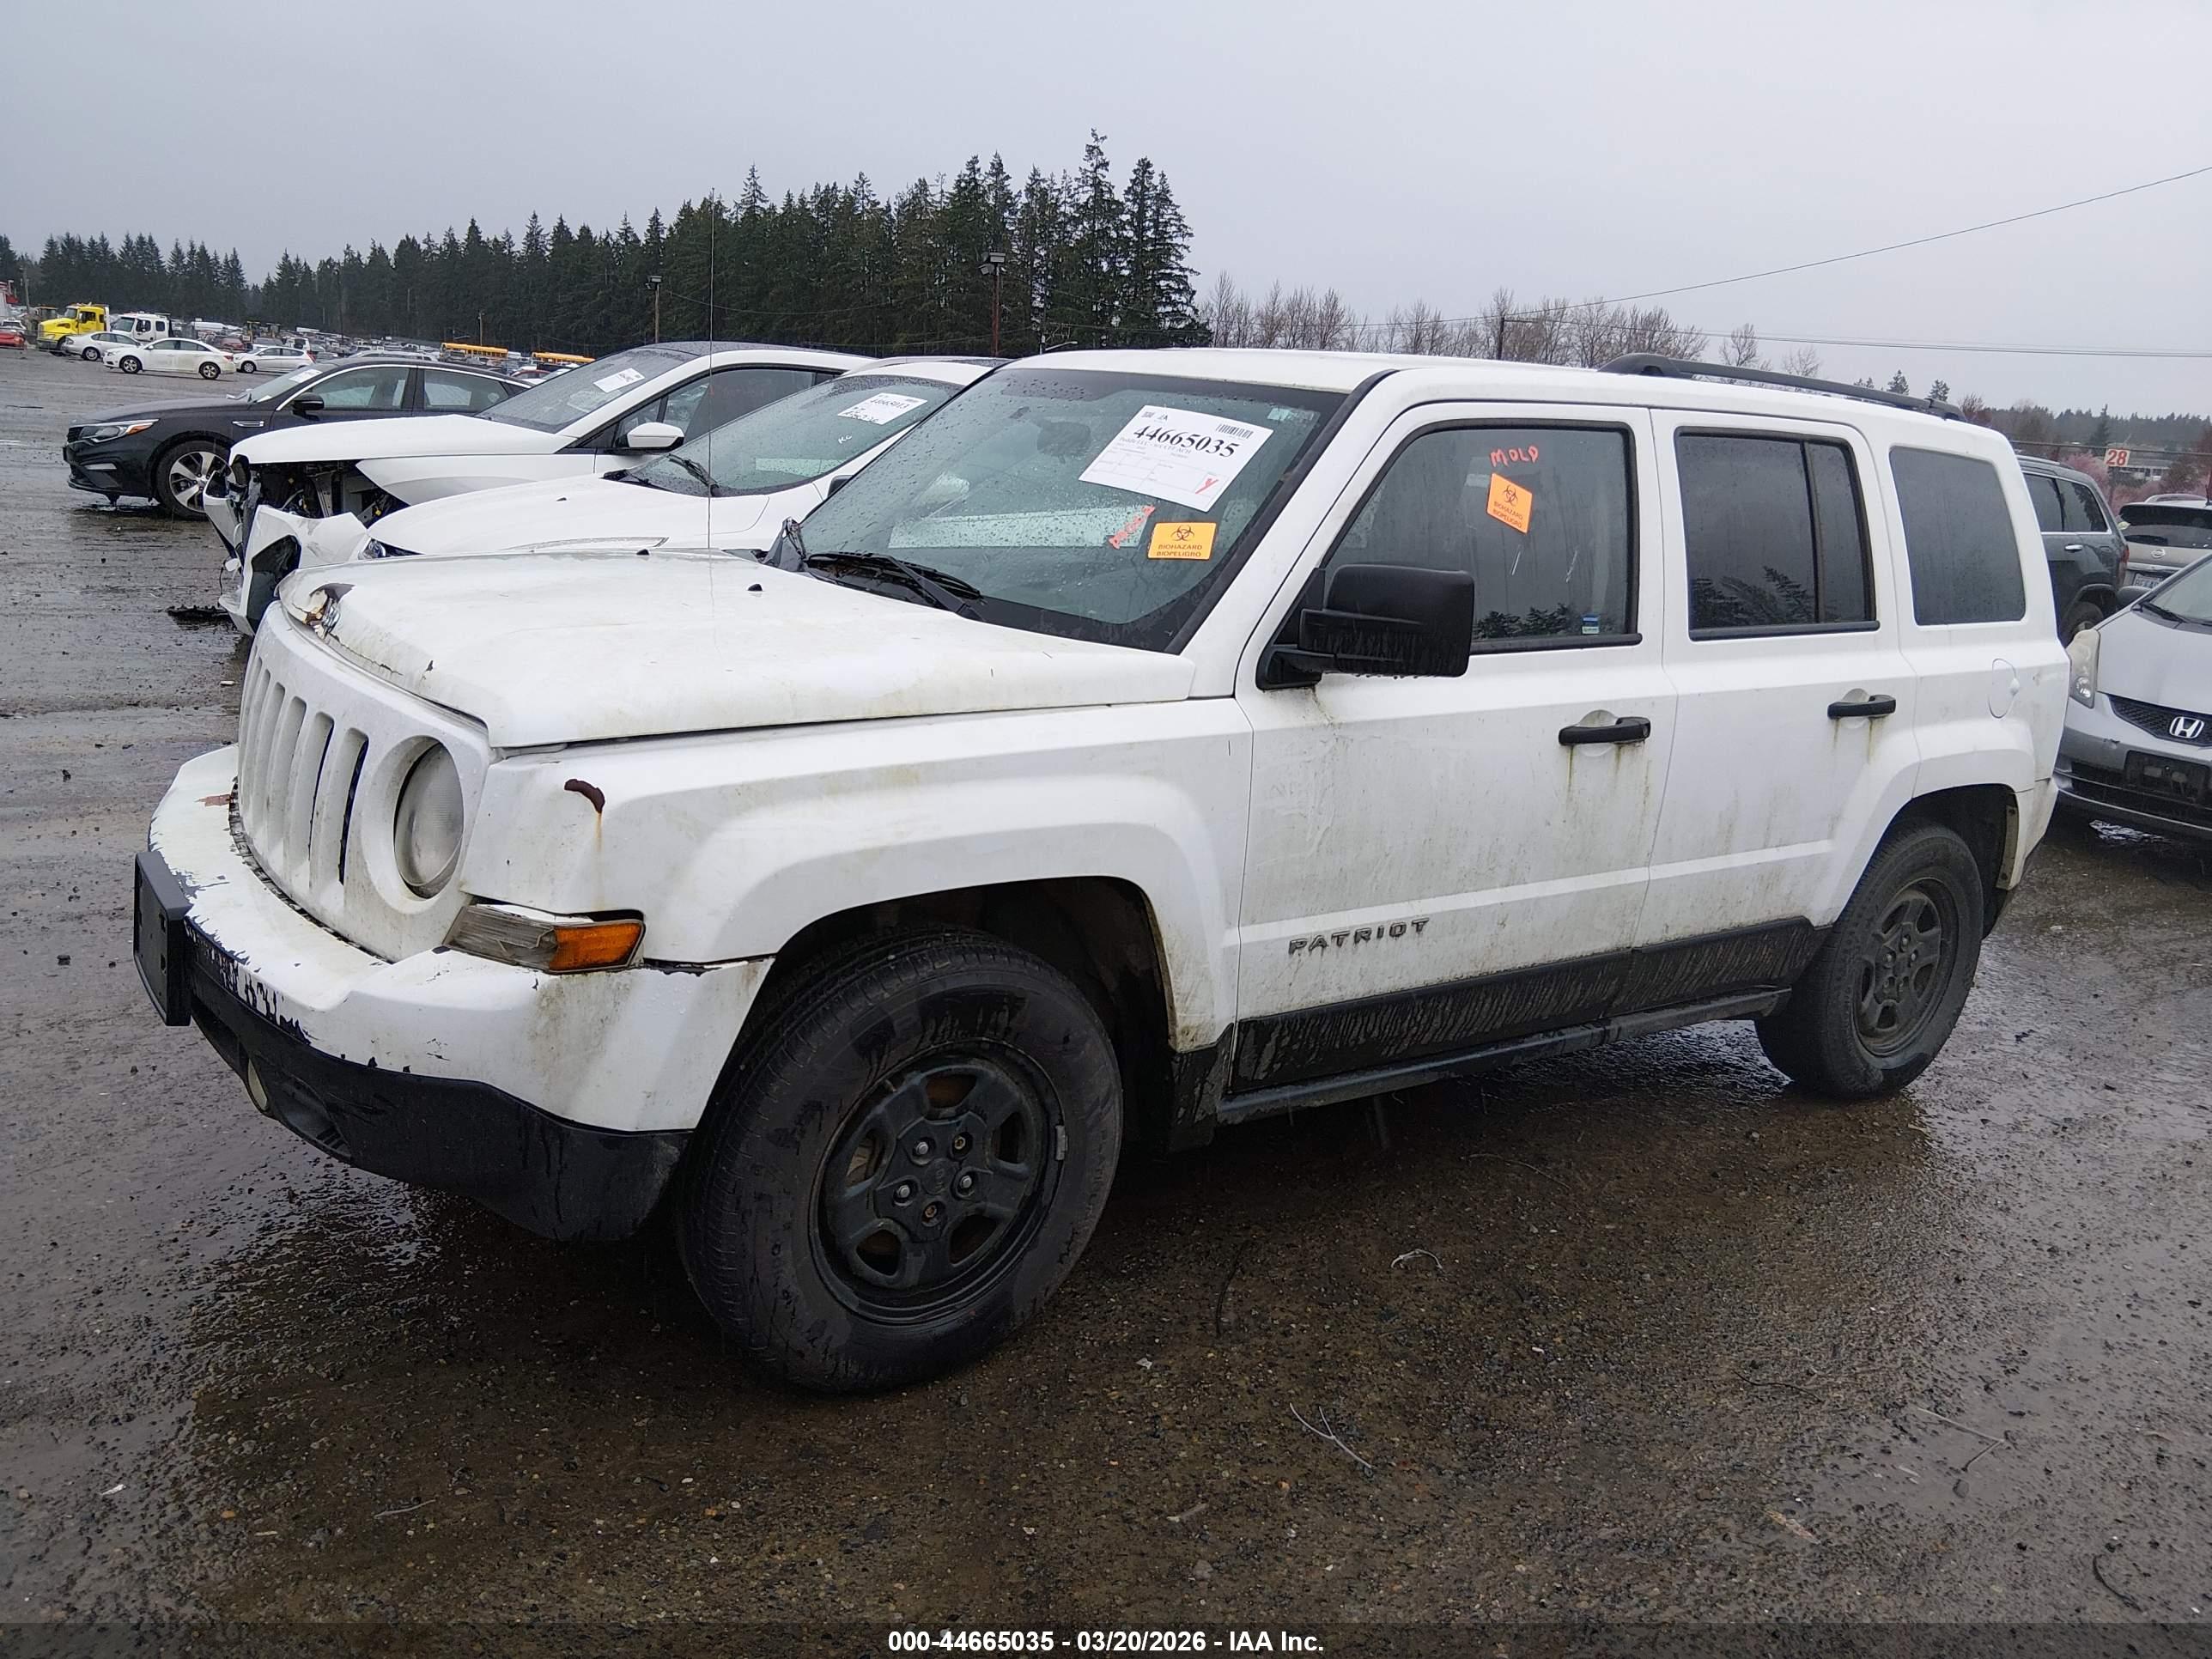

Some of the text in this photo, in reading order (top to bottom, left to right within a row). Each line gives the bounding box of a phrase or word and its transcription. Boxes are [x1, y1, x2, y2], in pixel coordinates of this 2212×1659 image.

[1133, 425, 1239, 457] 44665035
[2107, 451, 2127, 465] 28
[1492, 508, 1522, 529] BIOPELIGRO
[1494, 501, 1523, 520] BIOHAZARD
[1288, 917, 1430, 956] PATRIOT
